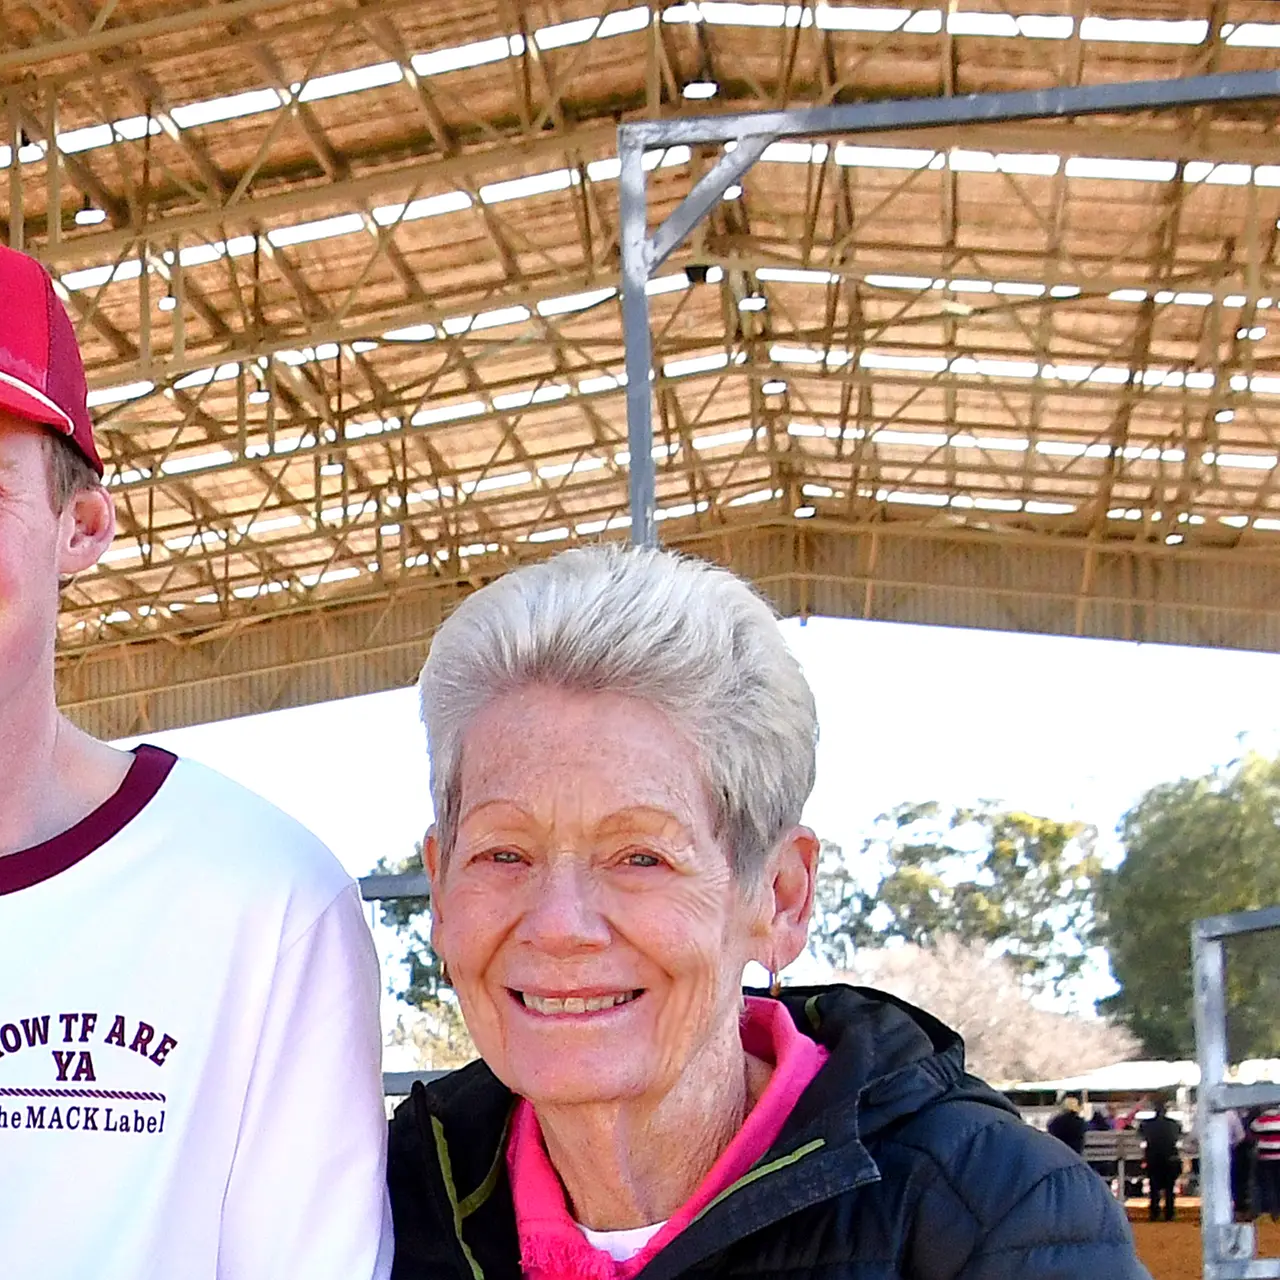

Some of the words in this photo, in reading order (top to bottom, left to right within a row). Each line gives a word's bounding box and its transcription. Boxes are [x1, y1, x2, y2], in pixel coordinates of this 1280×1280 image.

[59, 1013, 98, 1043] TF
[104, 1014, 178, 1067] ARE
[51, 1050, 97, 1082] YA
